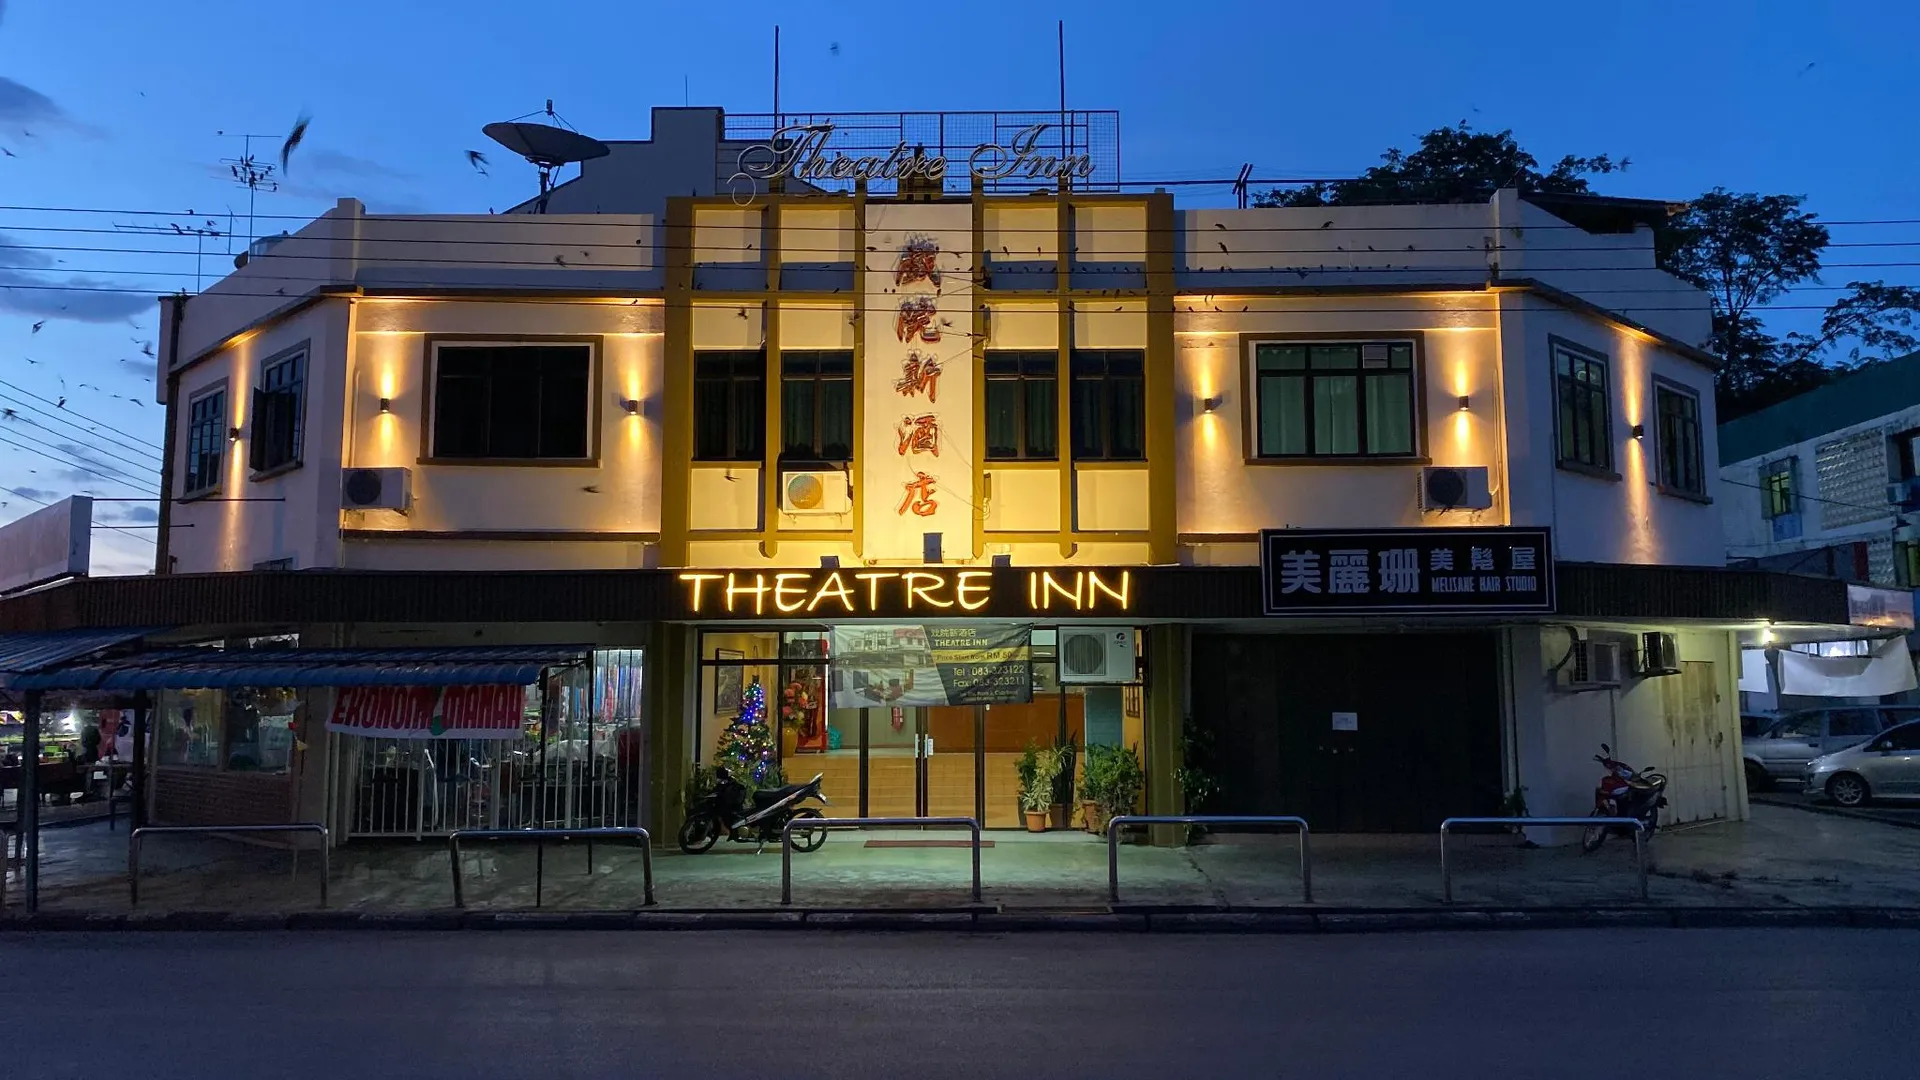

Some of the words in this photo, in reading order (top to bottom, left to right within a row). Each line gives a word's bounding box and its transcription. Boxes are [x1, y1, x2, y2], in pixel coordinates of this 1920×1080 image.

[736, 123, 947, 188] Theatre
[968, 122, 1096, 180] Inn
[1280, 549, 1421, 594] 美麗珊
[1480, 576, 1501, 592] HAIR
[1505, 575, 1537, 592] STUDIO
[679, 572, 993, 614] THEATRE
[1029, 571, 1129, 610] INN
[935, 639, 970, 647] THEATRE
[953, 667, 965, 676] Tel
